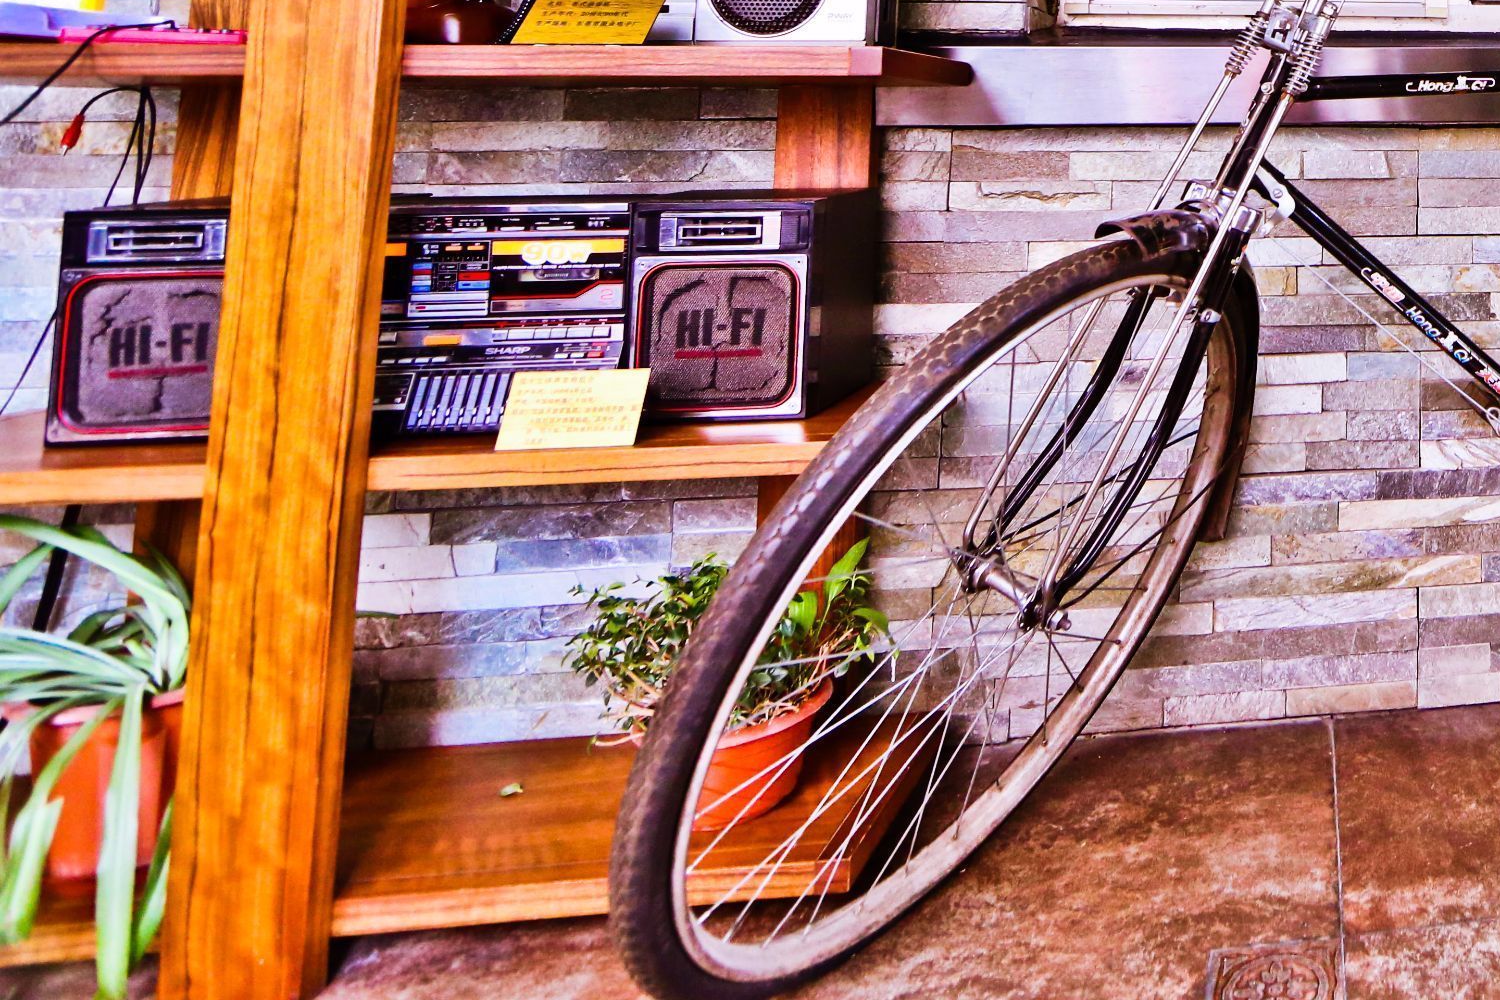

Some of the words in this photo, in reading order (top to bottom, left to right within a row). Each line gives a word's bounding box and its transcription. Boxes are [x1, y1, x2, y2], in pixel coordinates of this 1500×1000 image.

[1418, 79, 1454, 93] Hong
[676, 308, 767, 349] HI-FI
[1405, 305, 1442, 340] Hong
[109, 322, 211, 367] HI-FI
[484, 346, 531, 355] SHARP
